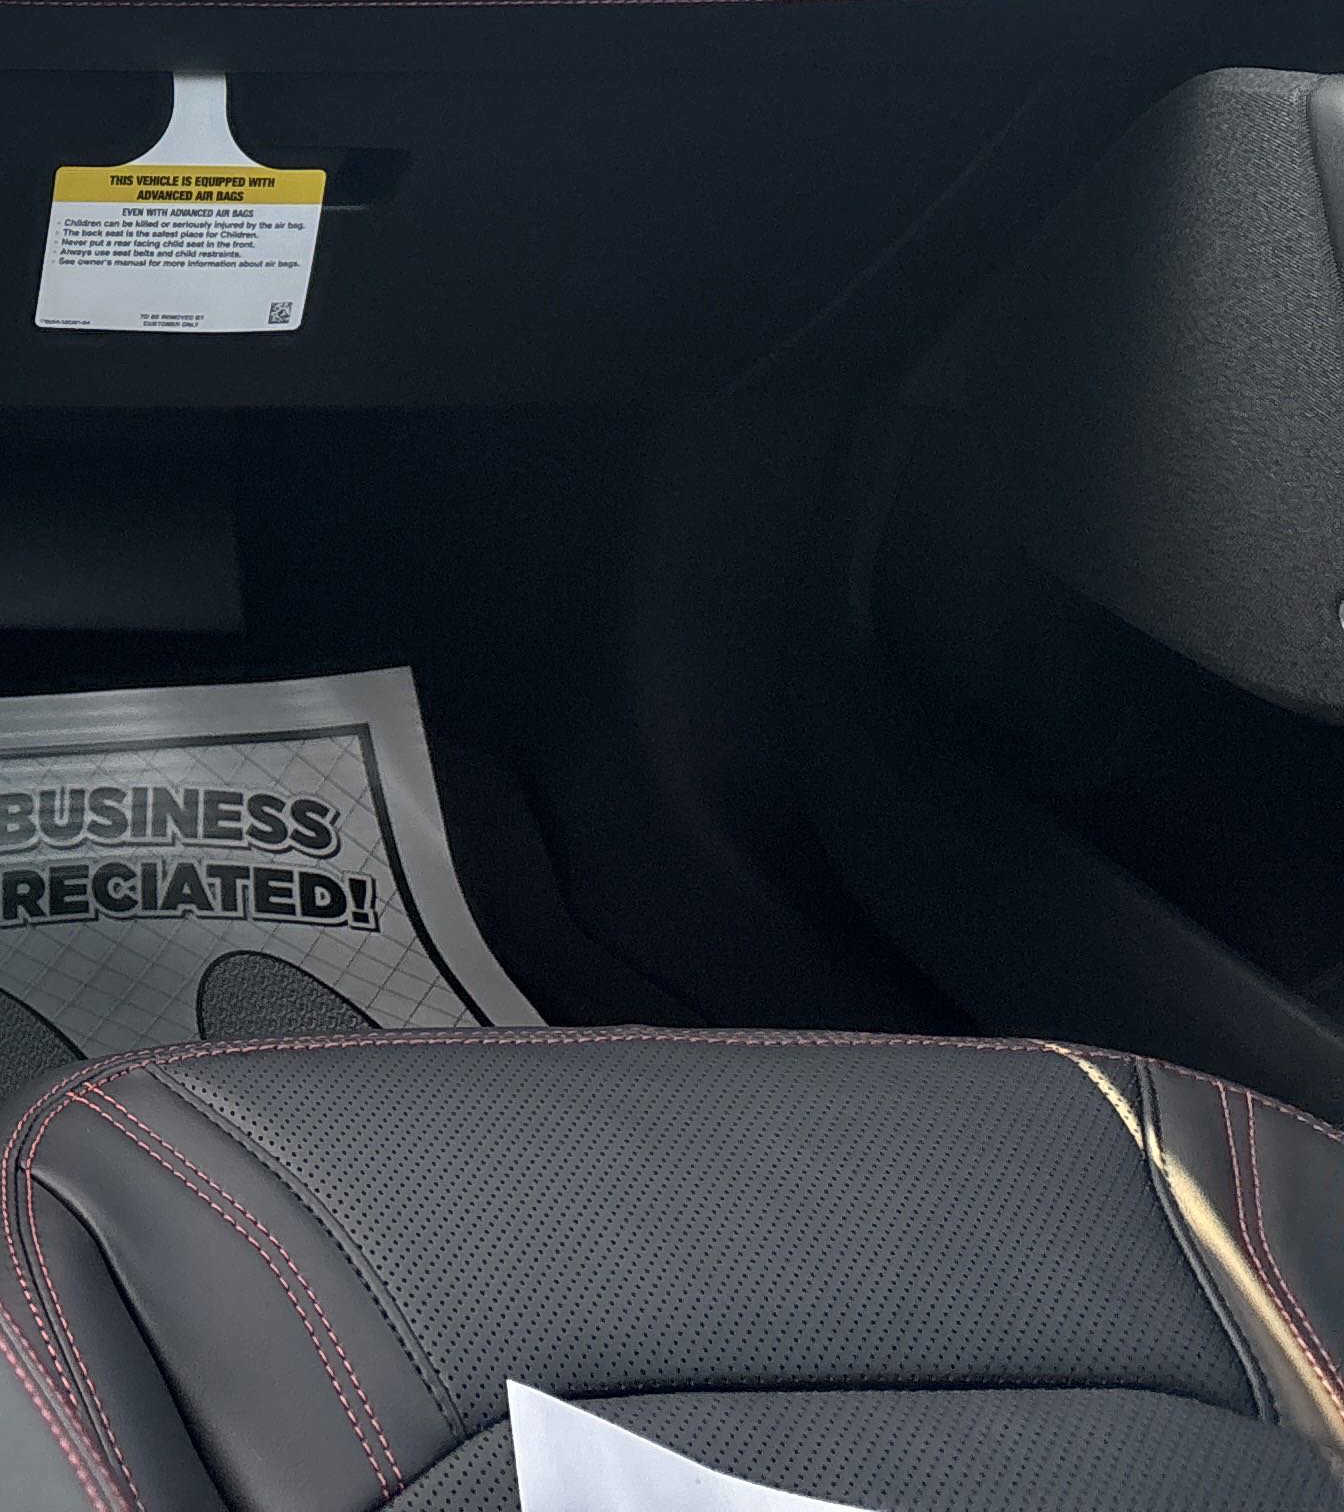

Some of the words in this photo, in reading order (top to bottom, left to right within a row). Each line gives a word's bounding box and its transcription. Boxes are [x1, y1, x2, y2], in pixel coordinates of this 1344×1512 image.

[110, 175, 133, 186] THIS
[136, 175, 179, 186] VEHICLE
[182, 176, 192, 187] IS
[195, 176, 246, 187] EQUIPPED
[248, 177, 276, 188] WITH
[136, 190, 193, 200] ADVANCED
[195, 190, 213, 201] AIR
[216, 191, 244, 201] BAGS
[122, 208, 144, 216] EVEN
[146, 208, 168, 216] WITH
[170, 208, 213, 217] ADVANCED
[216, 209, 231, 217] AIR
[232, 209, 254, 218] BAGS
[64, 219, 102, 227] Children
[136, 220, 158, 228] killed
[173, 221, 212, 230] seriously
[214, 221, 244, 230] injured
[246, 222, 256, 230] by
[180, 231, 204, 239] place
[90, 240, 104, 248] put
[134, 240, 160, 248] facing
[60, 249, 91, 257] Always
